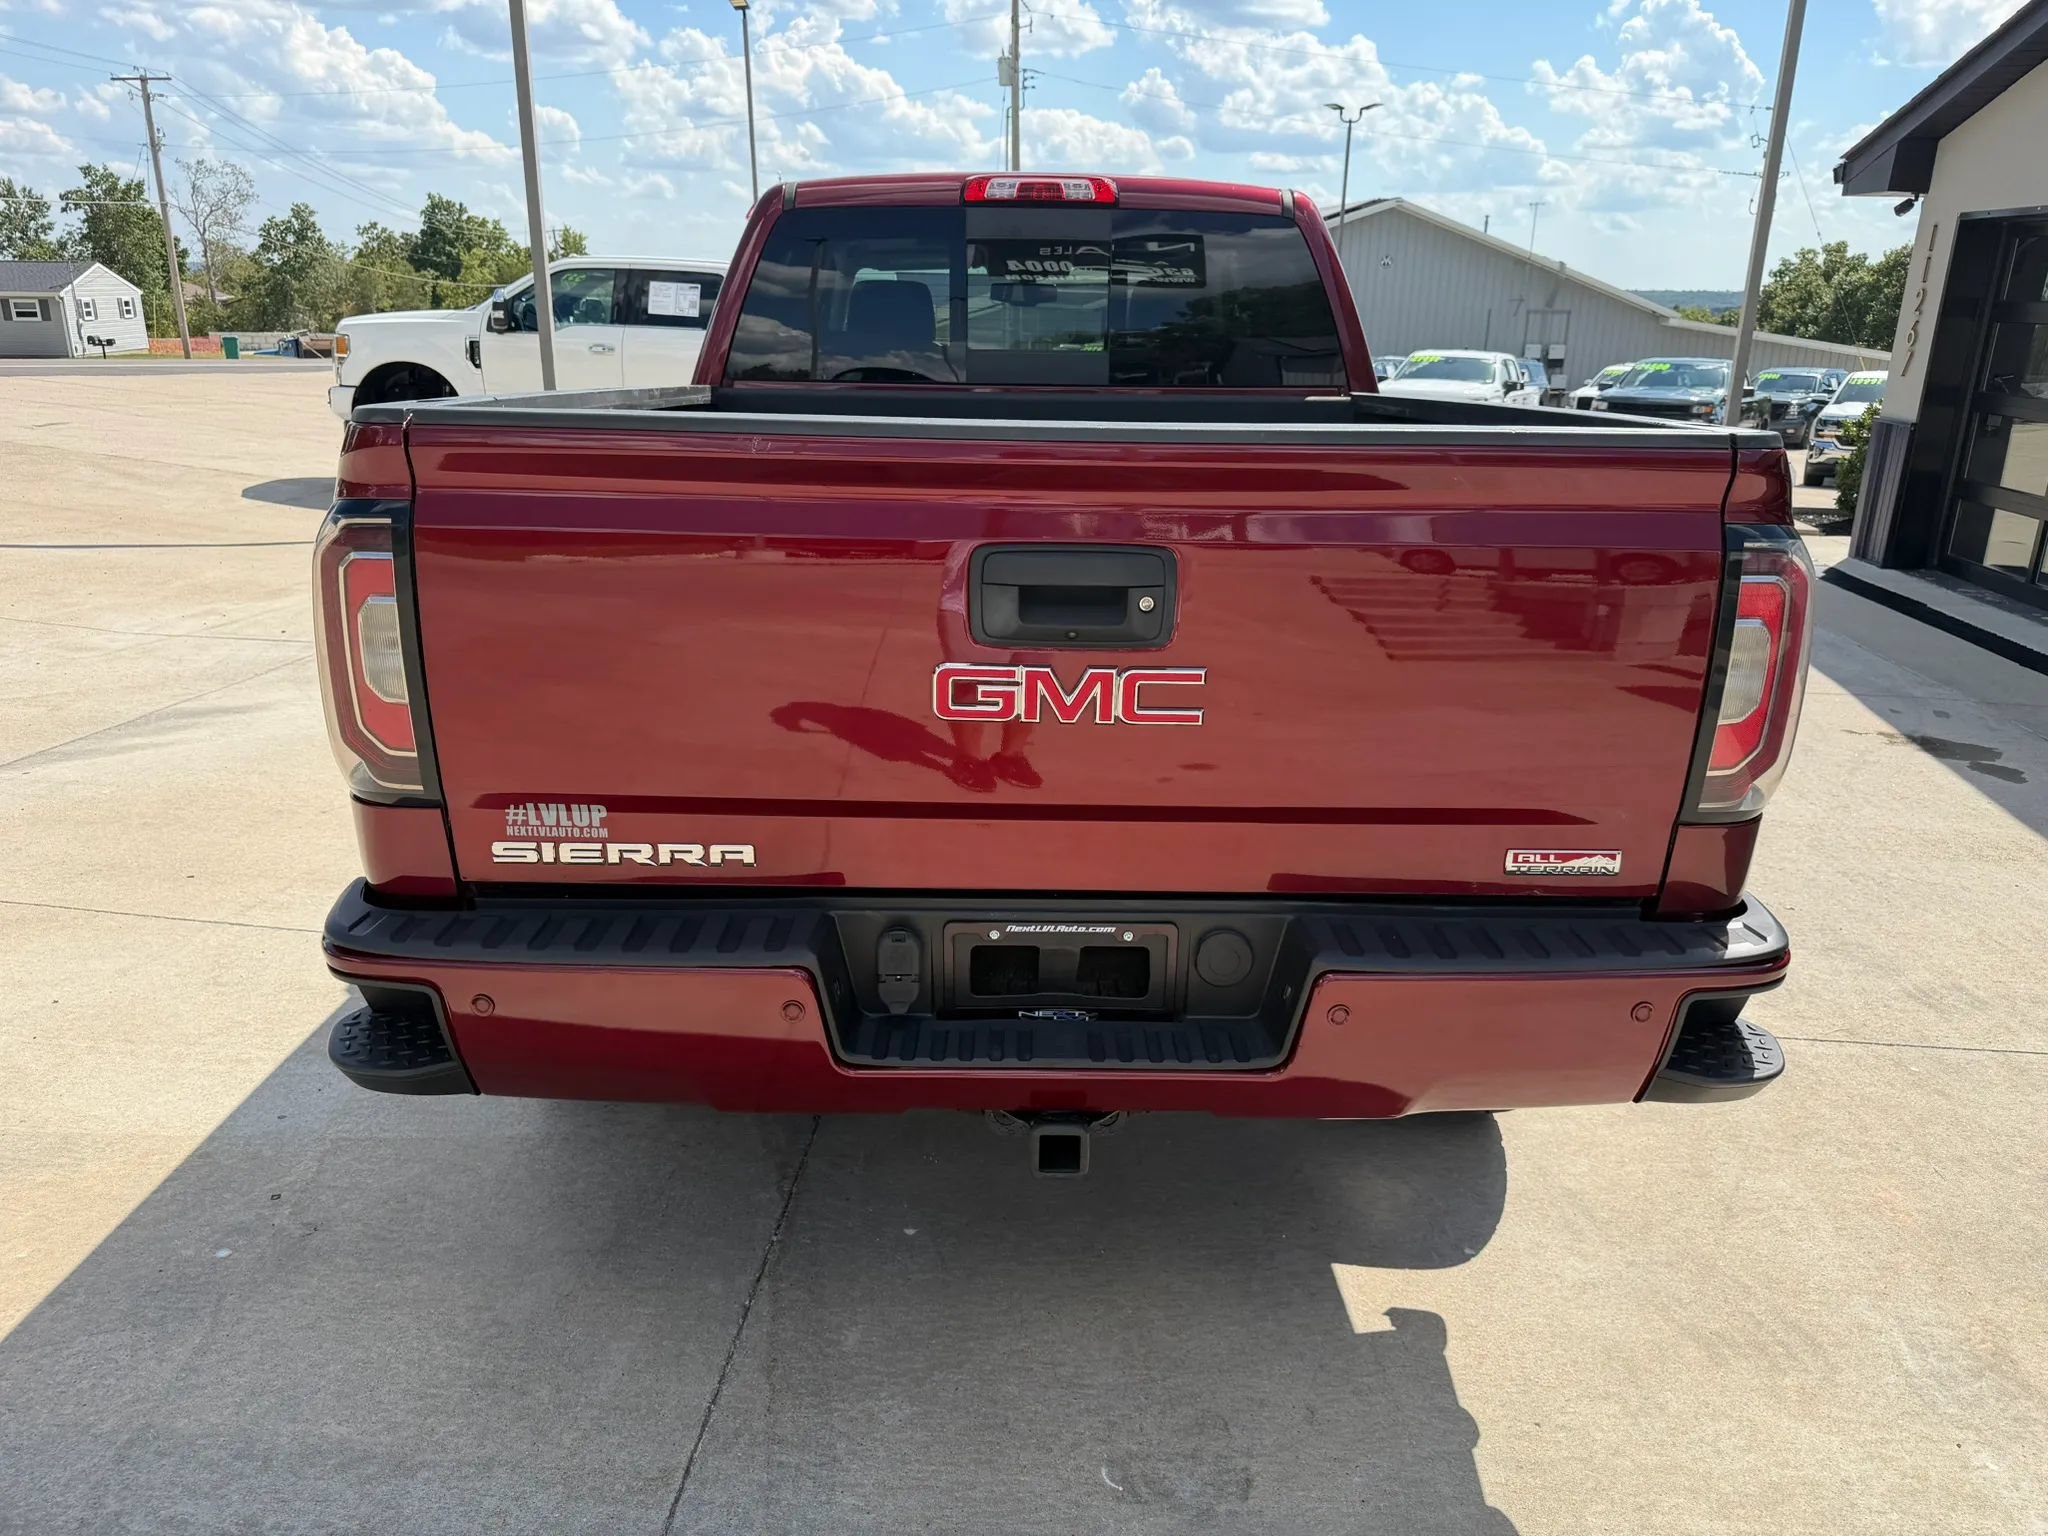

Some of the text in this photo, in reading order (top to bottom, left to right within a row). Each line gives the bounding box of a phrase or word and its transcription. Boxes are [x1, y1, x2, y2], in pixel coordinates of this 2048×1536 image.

[933, 663, 1207, 726] GMC
[505, 803, 608, 826] #LVLUP
[506, 825, 609, 838] NEXTLVLAUTO.COM
[491, 841, 757, 866] SIERRA
[1517, 854, 1562, 862] ALL
[1511, 865, 1617, 875] TERRAIN
[1005, 925, 1117, 933] NextLVLAuto.com
